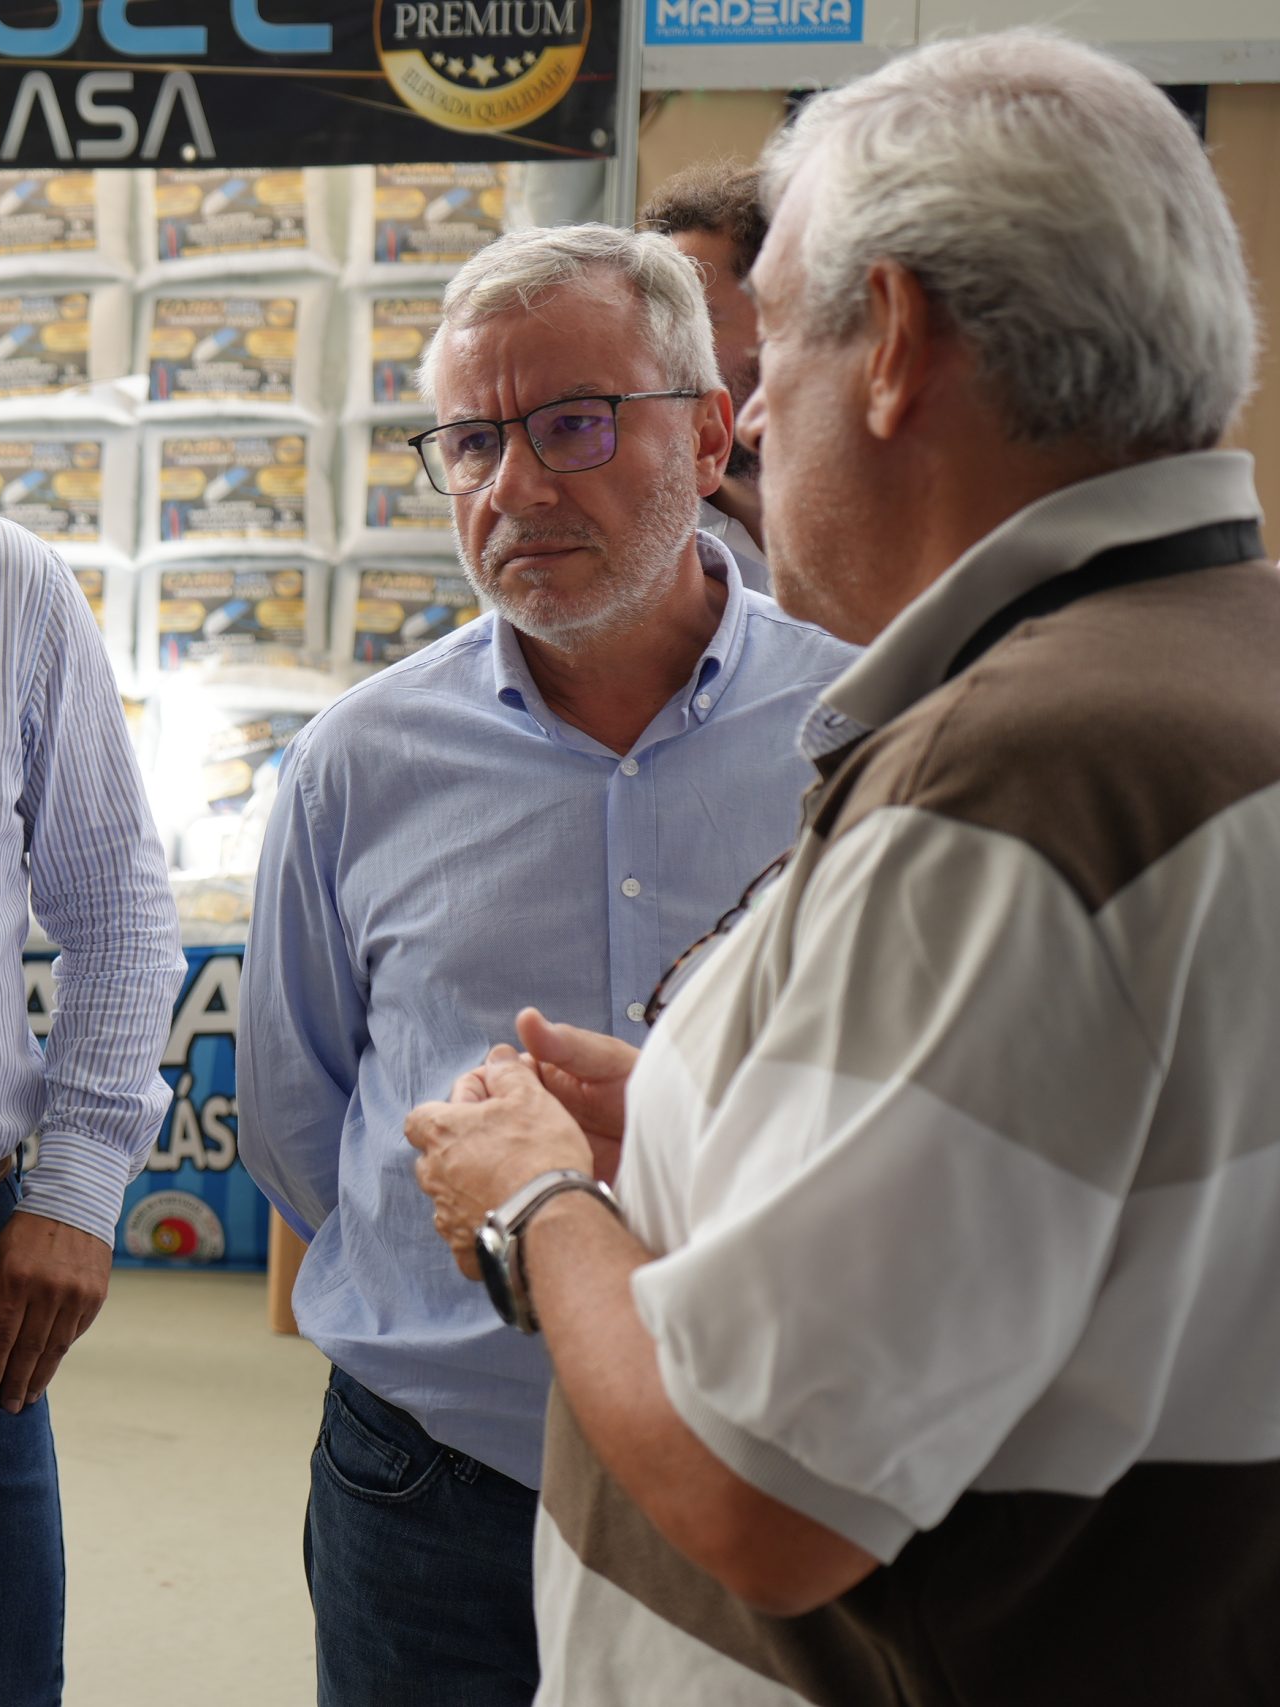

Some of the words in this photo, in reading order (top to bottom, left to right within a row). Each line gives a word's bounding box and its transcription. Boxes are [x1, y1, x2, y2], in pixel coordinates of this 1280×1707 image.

[393, 0, 575, 39] PREMIUM
[656, 0, 851, 26] MADEIRA
[478, 62, 571, 124] QUALIDADE
